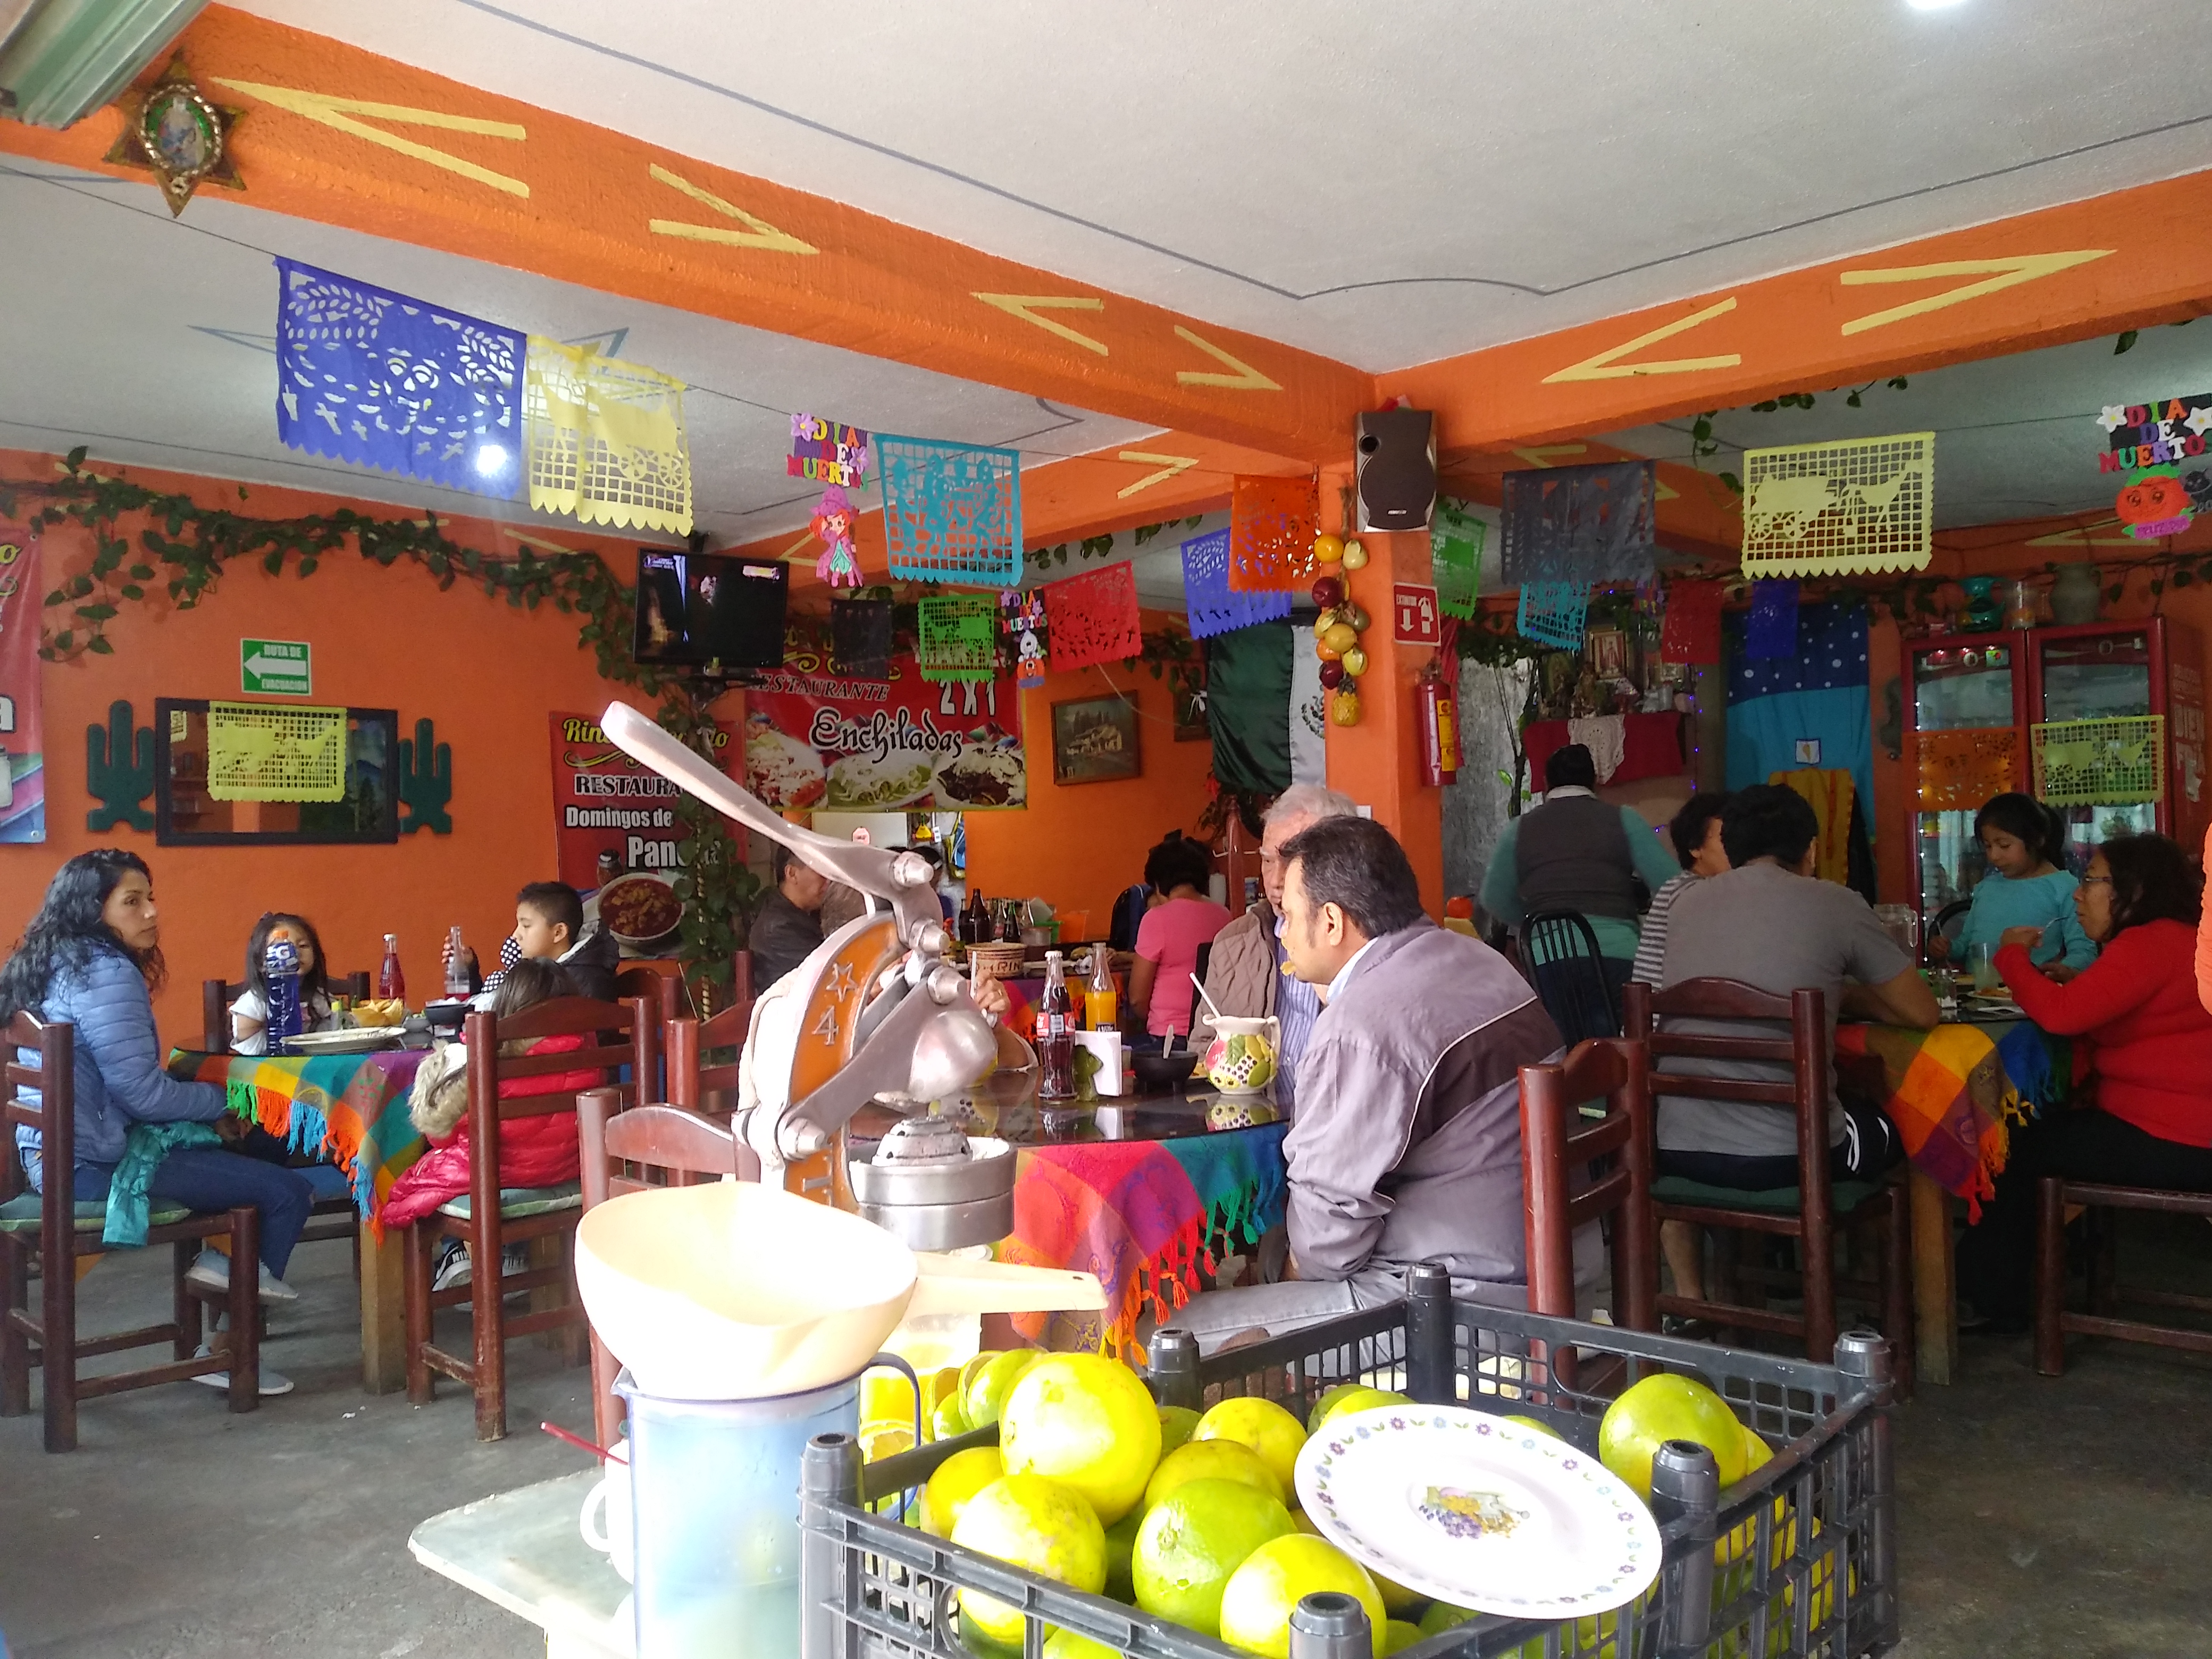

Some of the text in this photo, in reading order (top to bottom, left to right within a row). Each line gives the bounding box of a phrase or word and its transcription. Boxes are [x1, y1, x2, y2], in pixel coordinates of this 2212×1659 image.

[2125, 398, 2187, 427] DIA
[813, 418, 859, 448] DIA
[2139, 419, 2176, 443] DE
[821, 440, 849, 464] DE
[1013, 590, 1035, 607] DIA
[747, 674, 890, 701] ESTAURANTE
[809, 706, 962, 764] Enchiladas
[575, 774, 683, 797] RESTAURA
[566, 807, 650, 829] Domingos
[812, 1005, 839, 1045] 4
